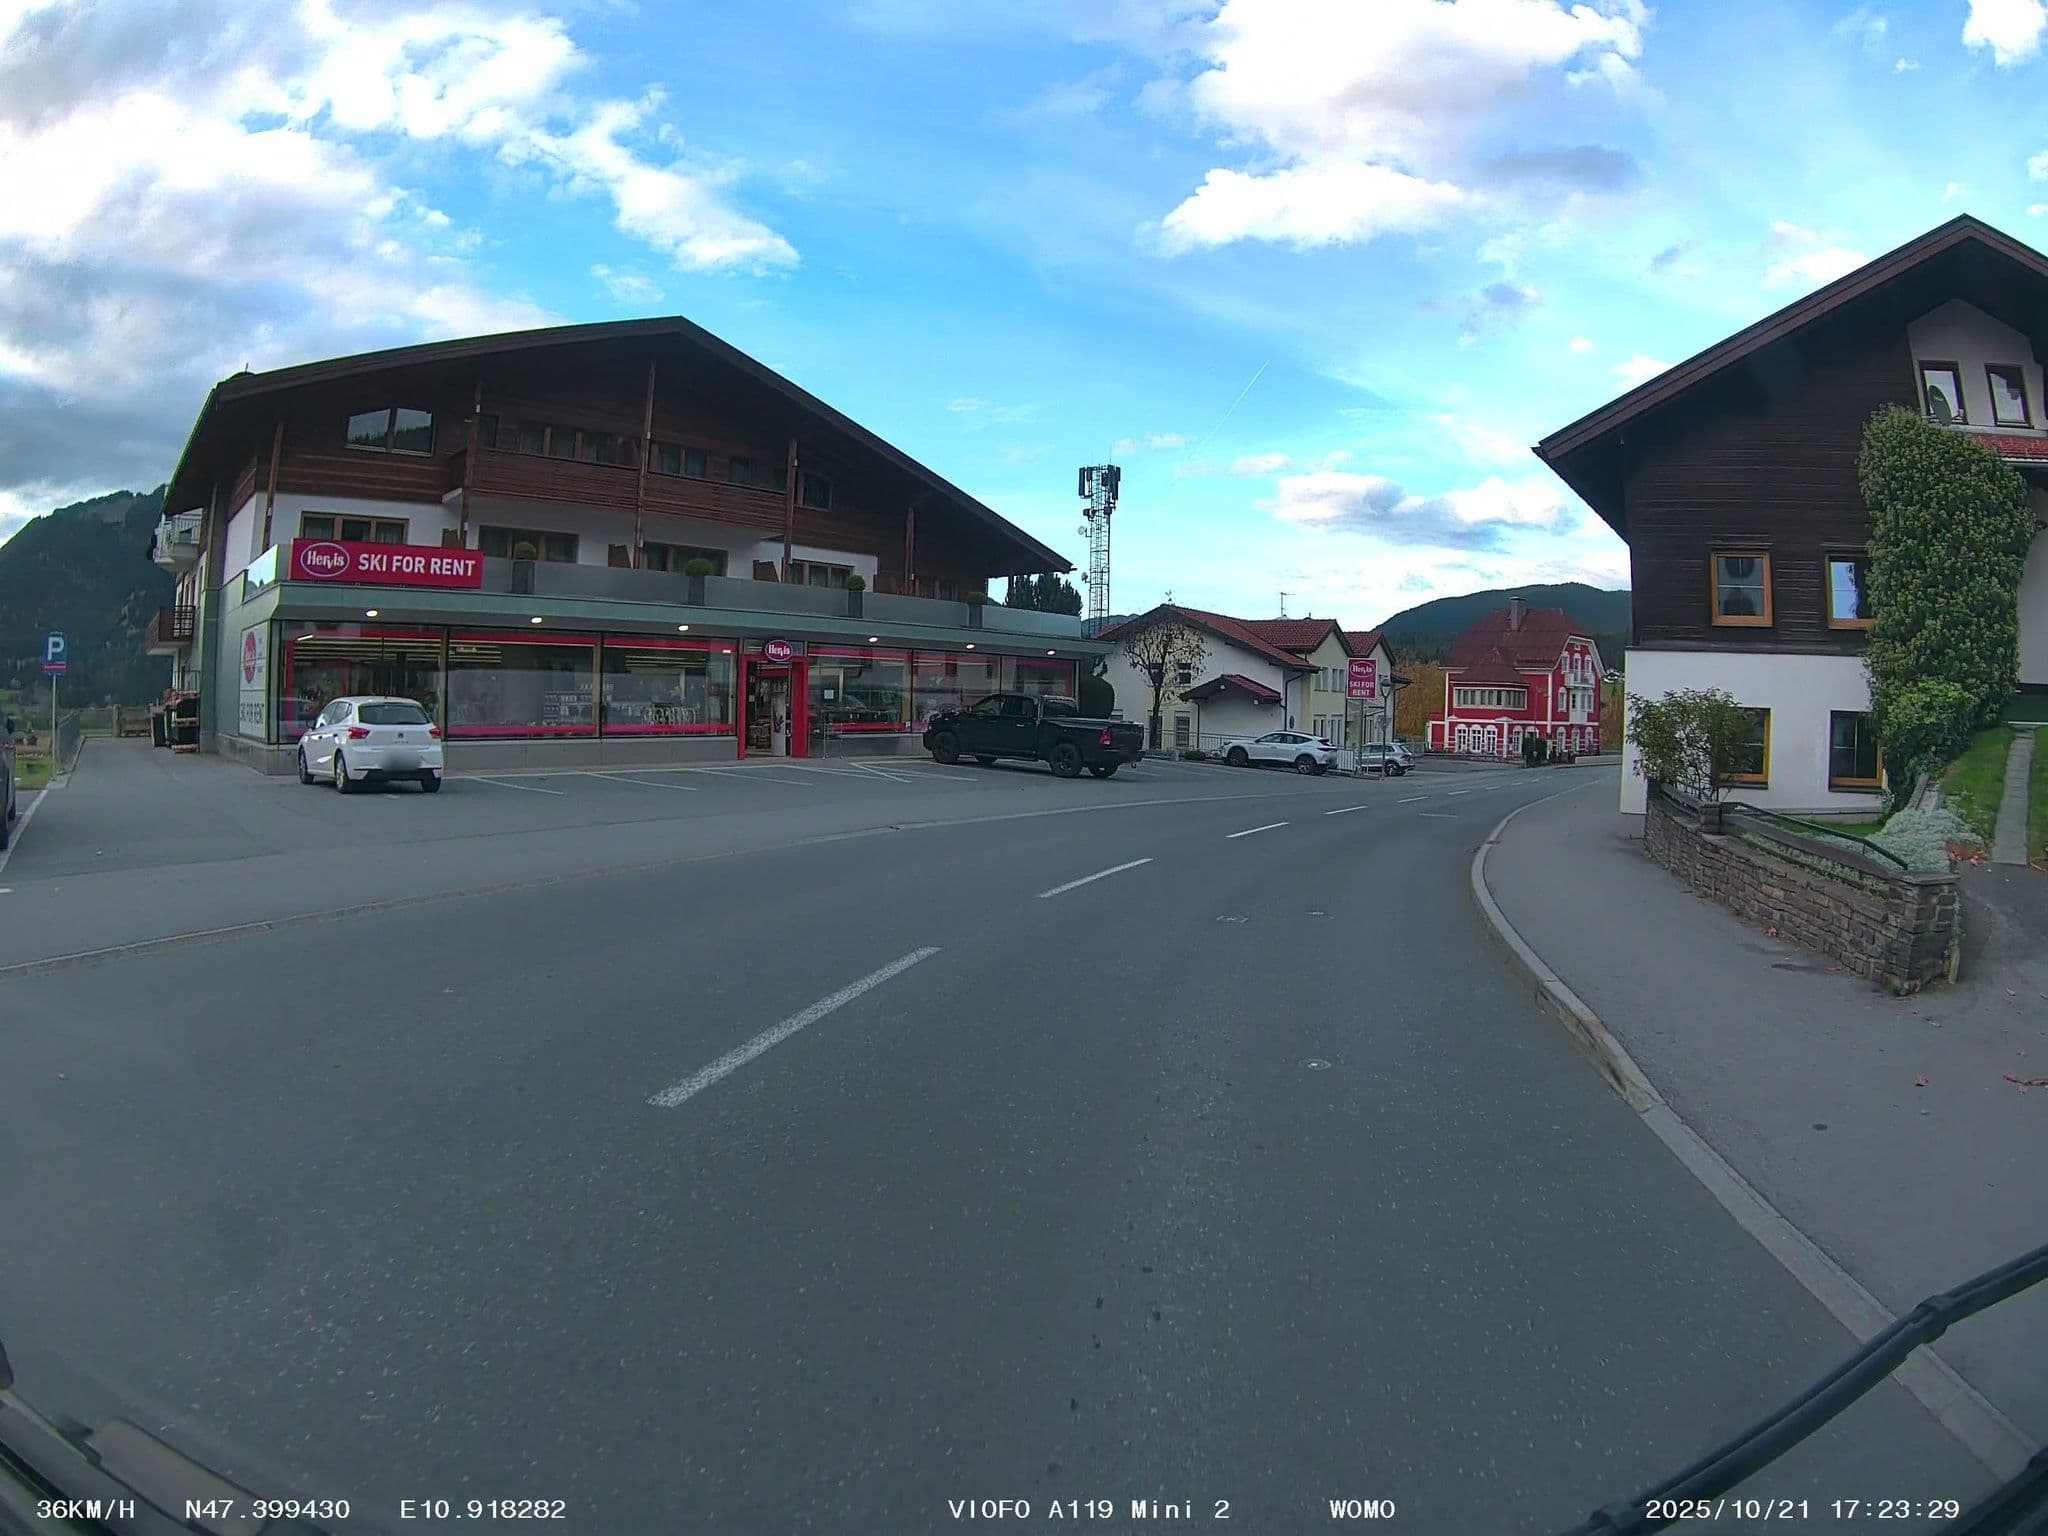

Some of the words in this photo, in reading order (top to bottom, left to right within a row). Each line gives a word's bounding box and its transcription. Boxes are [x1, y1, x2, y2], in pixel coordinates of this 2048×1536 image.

[306, 550, 346, 569] Hervis
[358, 553, 386, 572] SKI
[392, 556, 425, 573] FOR
[430, 558, 476, 576] RENT
[47, 636, 65, 661] P
